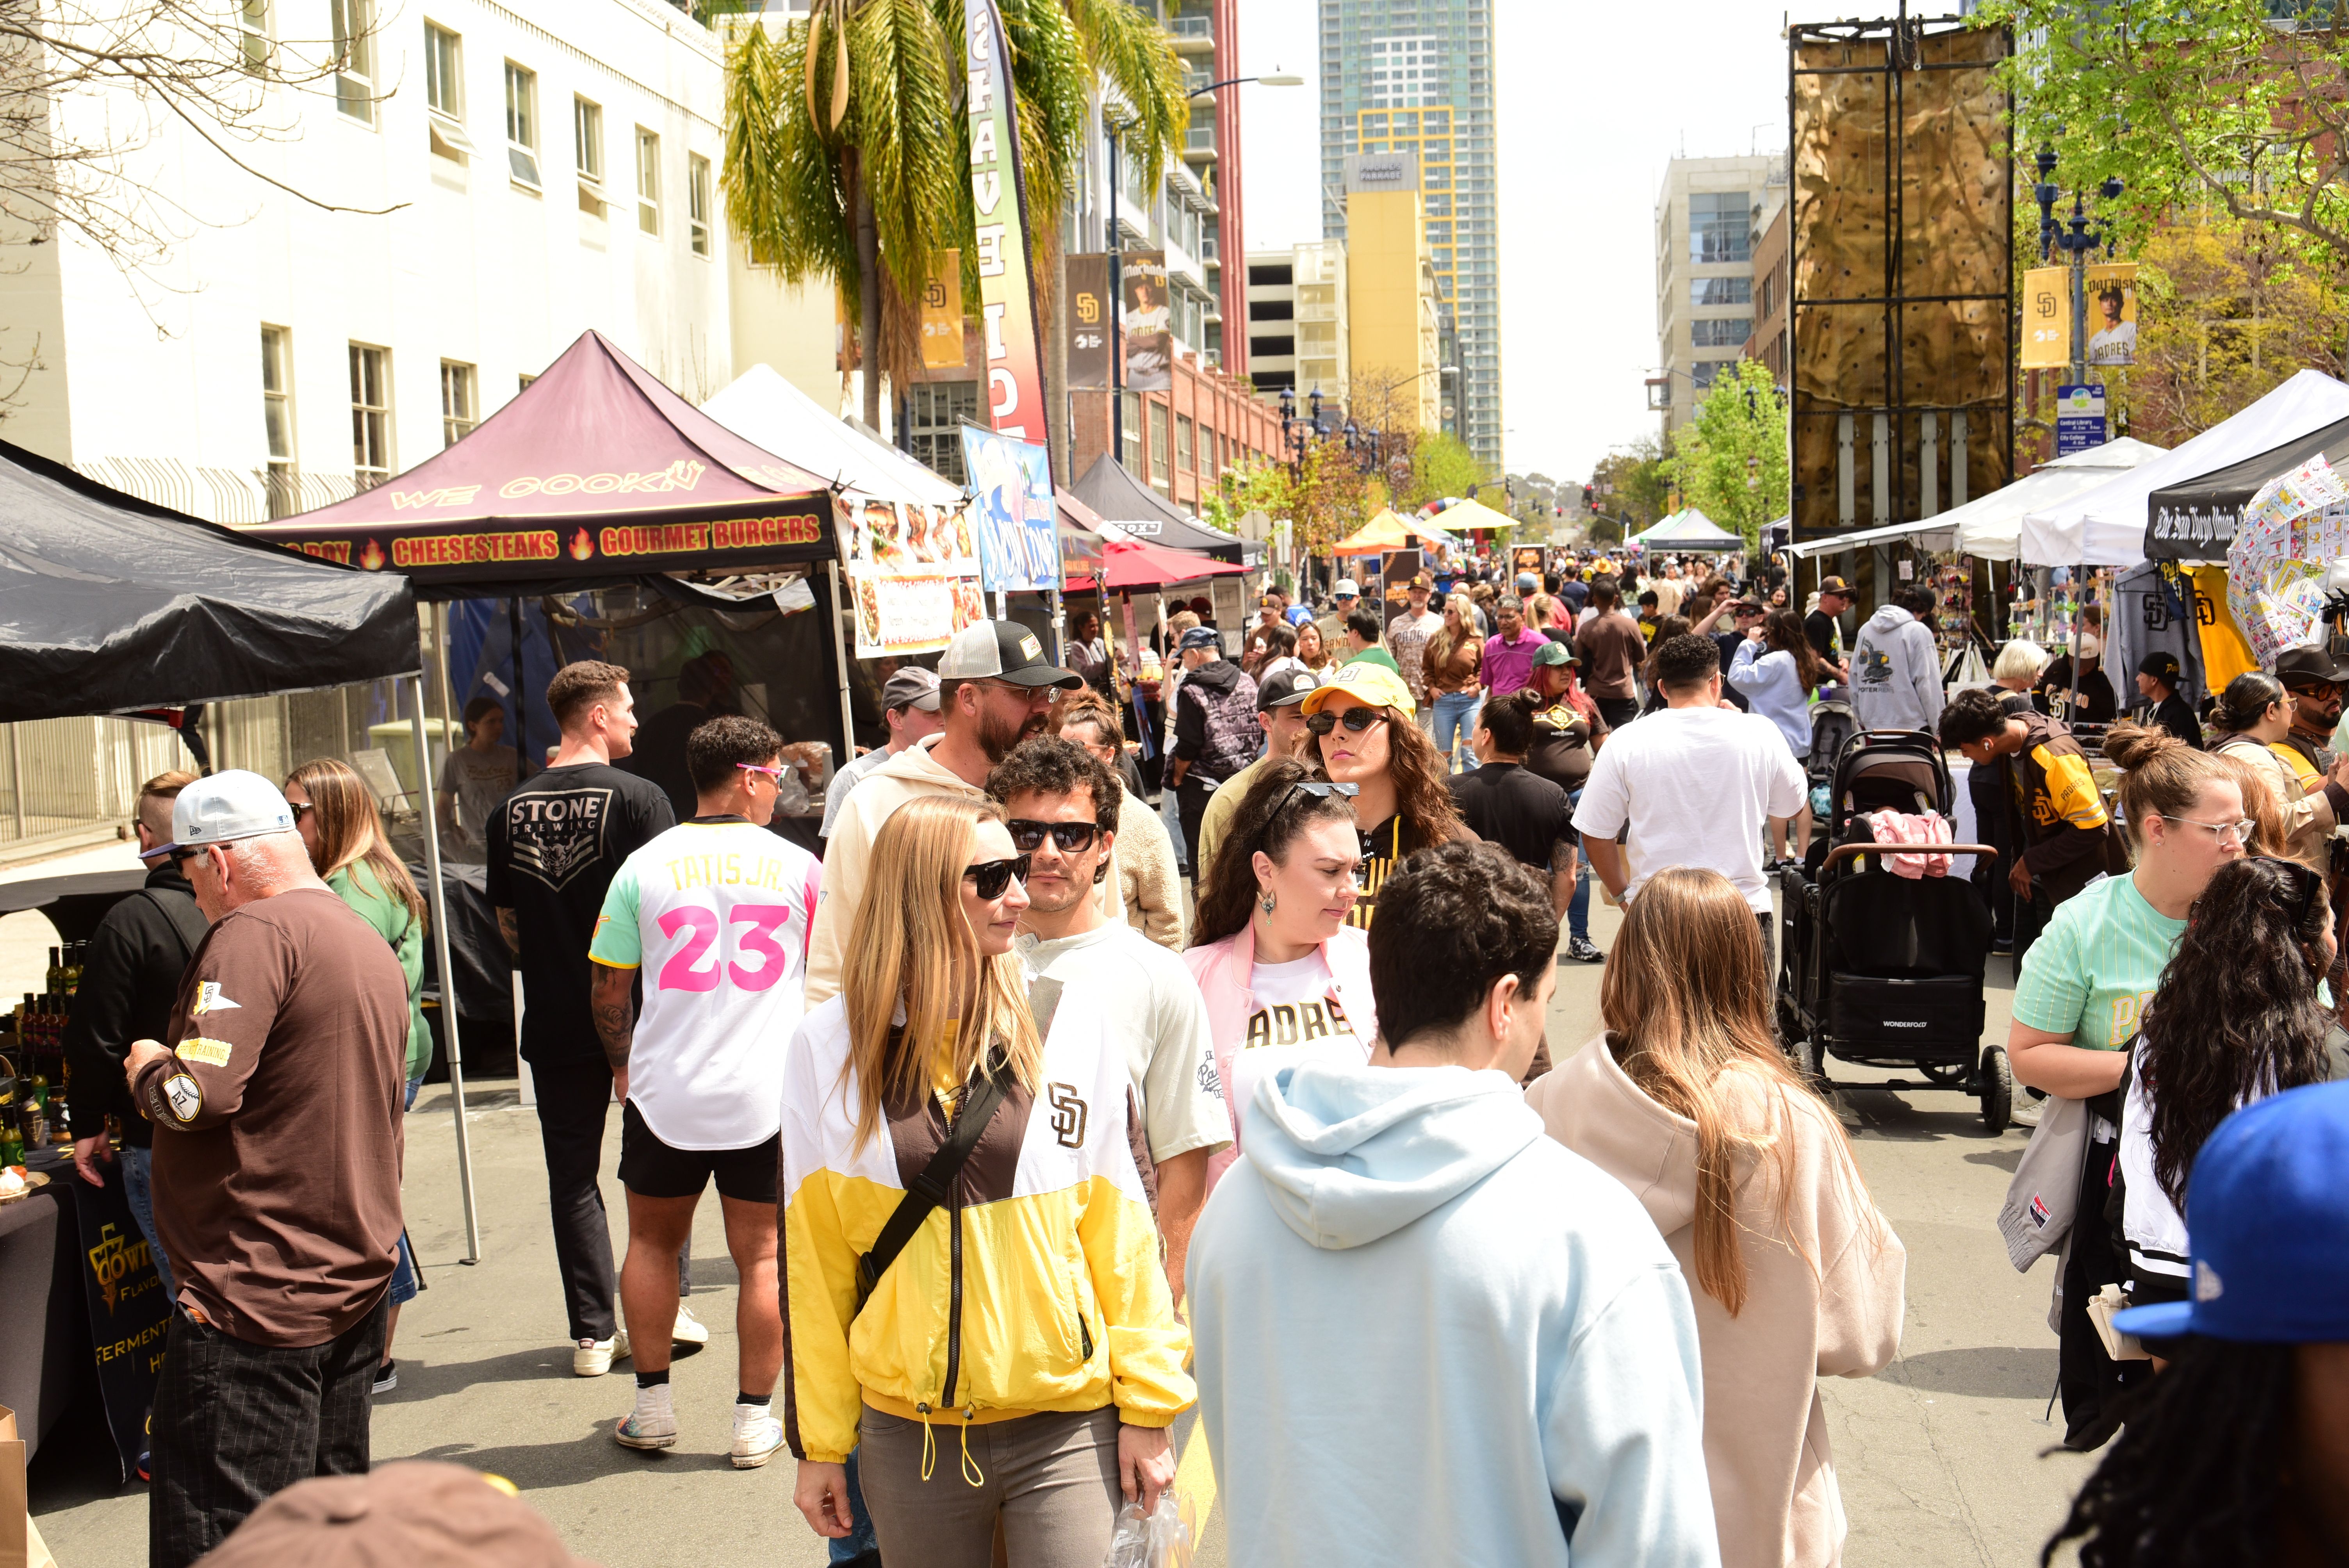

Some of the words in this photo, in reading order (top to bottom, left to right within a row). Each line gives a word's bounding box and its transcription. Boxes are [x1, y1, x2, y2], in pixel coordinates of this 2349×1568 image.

[1360, 163, 1403, 171] PADRES
[1360, 171, 1403, 181] PARKADE
[2037, 292, 2056, 317] SD
[390, 484, 483, 510] WE
[2154, 506, 2174, 540] The
[2169, 506, 2190, 541] San
[2190, 503, 2214, 549] Diego
[392, 530, 560, 567] CHEESESTEAKS
[600, 522, 710, 557] GOURMET
[712, 513, 821, 550] BURGERS
[980, 508, 1025, 583] SNOW
[2060, 778, 2085, 802] PADRES
[512, 797, 601, 824] STONE
[513, 820, 596, 835] BREWING
[666, 853, 740, 891] TATIS
[745, 856, 783, 892] JR.
[657, 905, 790, 992] 23
[176, 1045, 196, 1055] SPRING
[196, 1044, 226, 1060] TRAINING
[172, 1090, 187, 1109] AZ
[1048, 1081, 1088, 1149] SD
